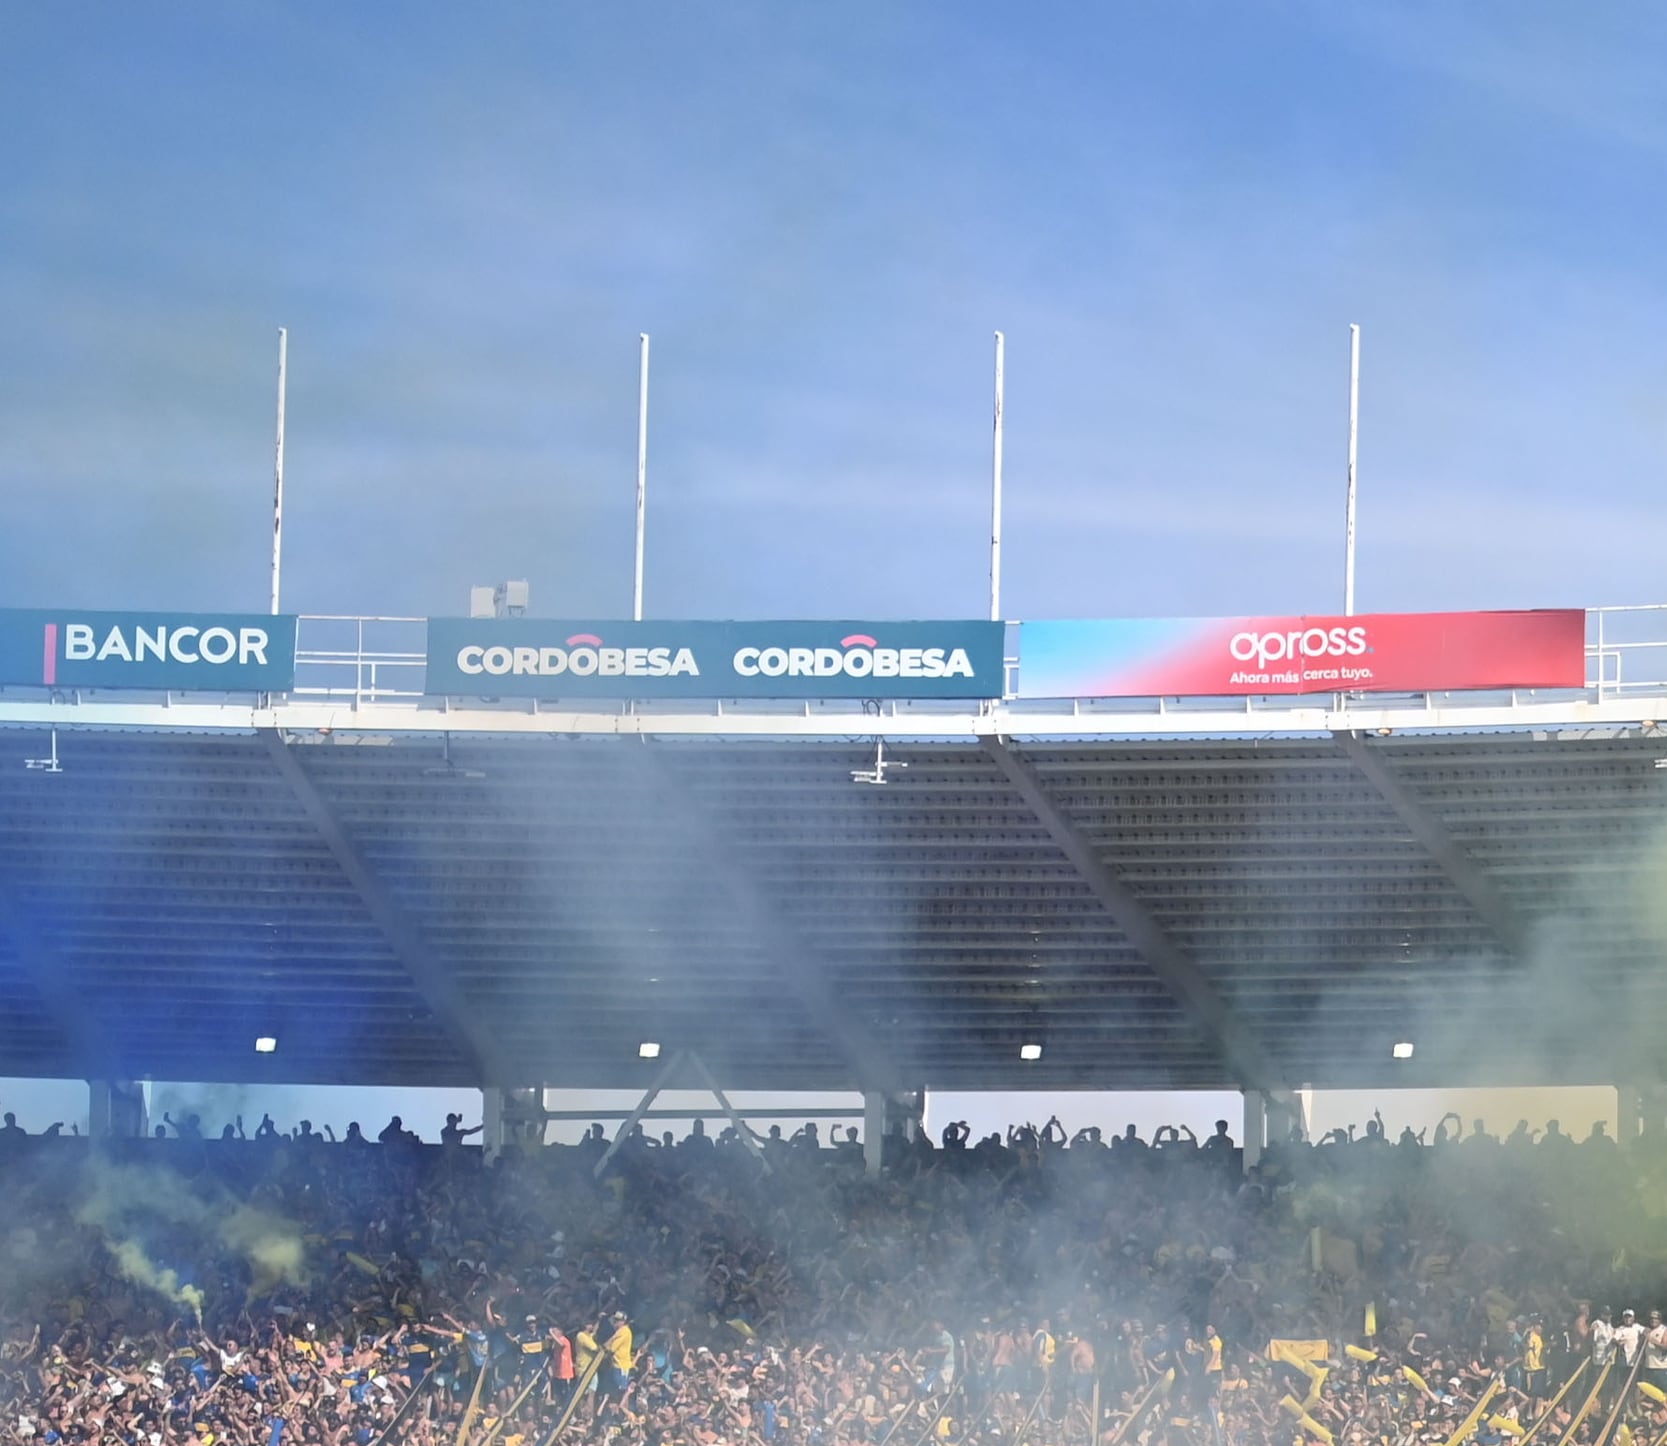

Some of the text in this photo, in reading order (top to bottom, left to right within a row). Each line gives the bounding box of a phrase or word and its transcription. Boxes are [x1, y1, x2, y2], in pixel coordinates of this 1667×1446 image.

[65, 624, 269, 666] BANCOR
[457, 643, 700, 678] CORDOBESA
[733, 644, 975, 680] CORDOBESA
[1230, 671, 1269, 684] Ahora
[1272, 670, 1299, 683] más
[1303, 669, 1339, 681] cerca
